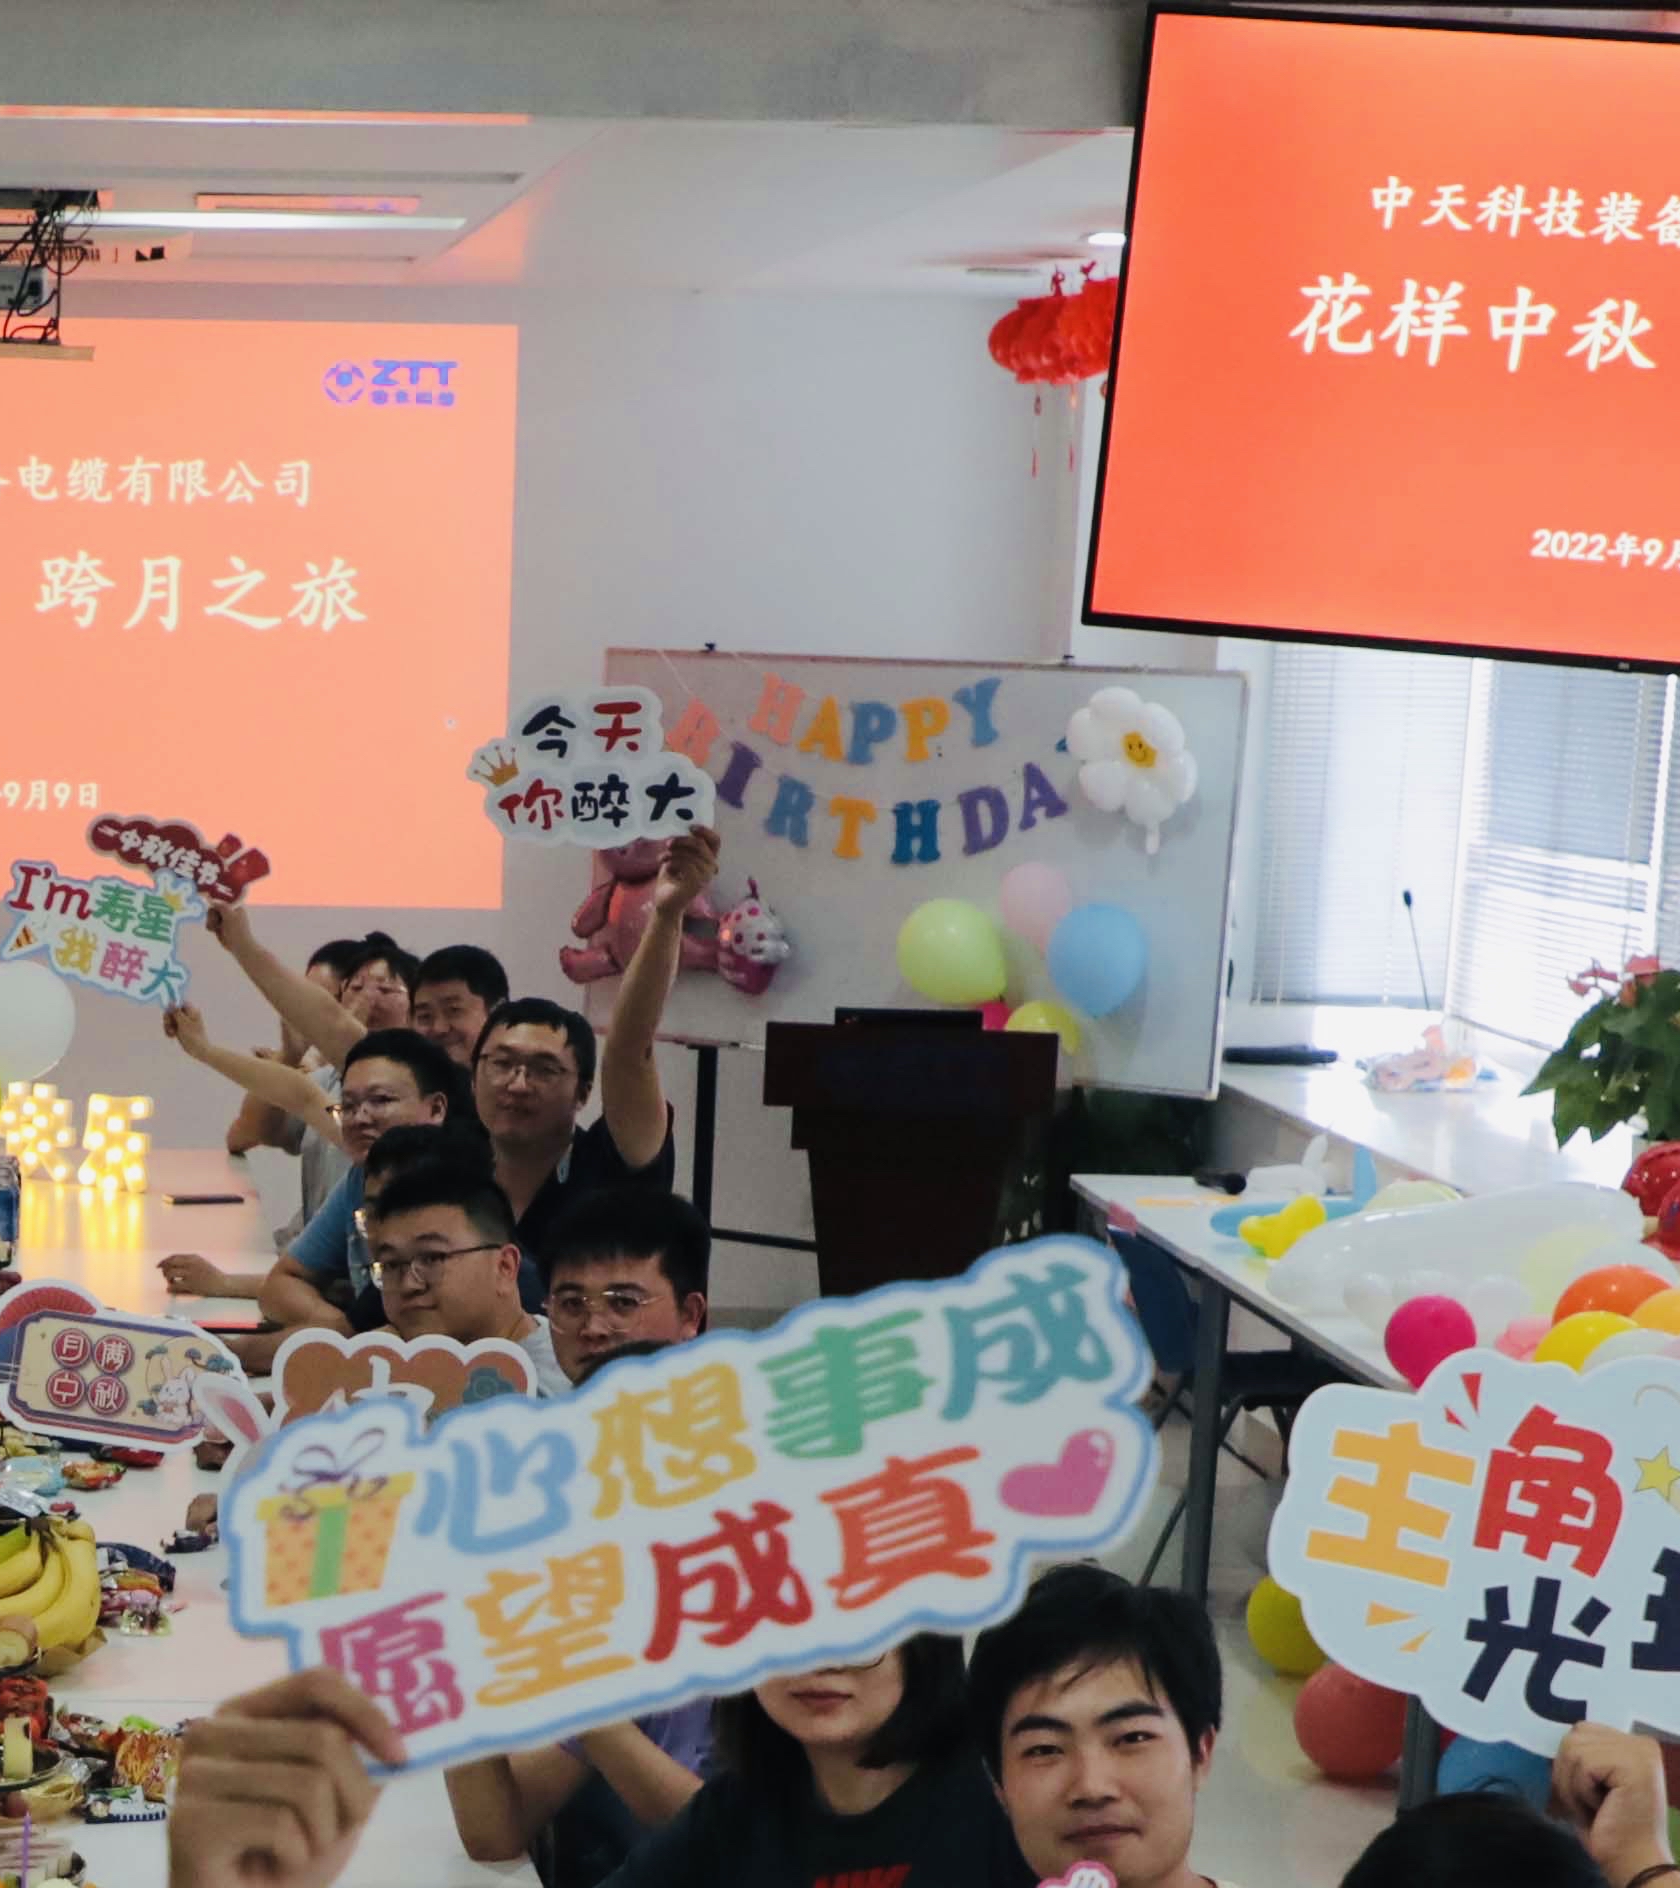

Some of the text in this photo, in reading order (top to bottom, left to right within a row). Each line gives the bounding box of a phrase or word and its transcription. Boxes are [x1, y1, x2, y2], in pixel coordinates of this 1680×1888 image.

[1290, 272, 1659, 374] 花样中秋
[371, 359, 457, 386] ZTT
[33, 553, 369, 634] 跨月之旅
[520, 699, 643, 759] 今天
[747, 671, 1003, 765] HAPPY
[498, 773, 698, 832] 你醉大
[666, 697, 1068, 866] BIRTHDA
[118, 828, 221, 886] 中秋佳节
[54, 925, 185, 1001] 我醉大
[413, 1260, 1115, 1557] 心想事成
[1303, 1404, 1625, 1588] 主角
[316, 1446, 995, 1740] 愿望成真
